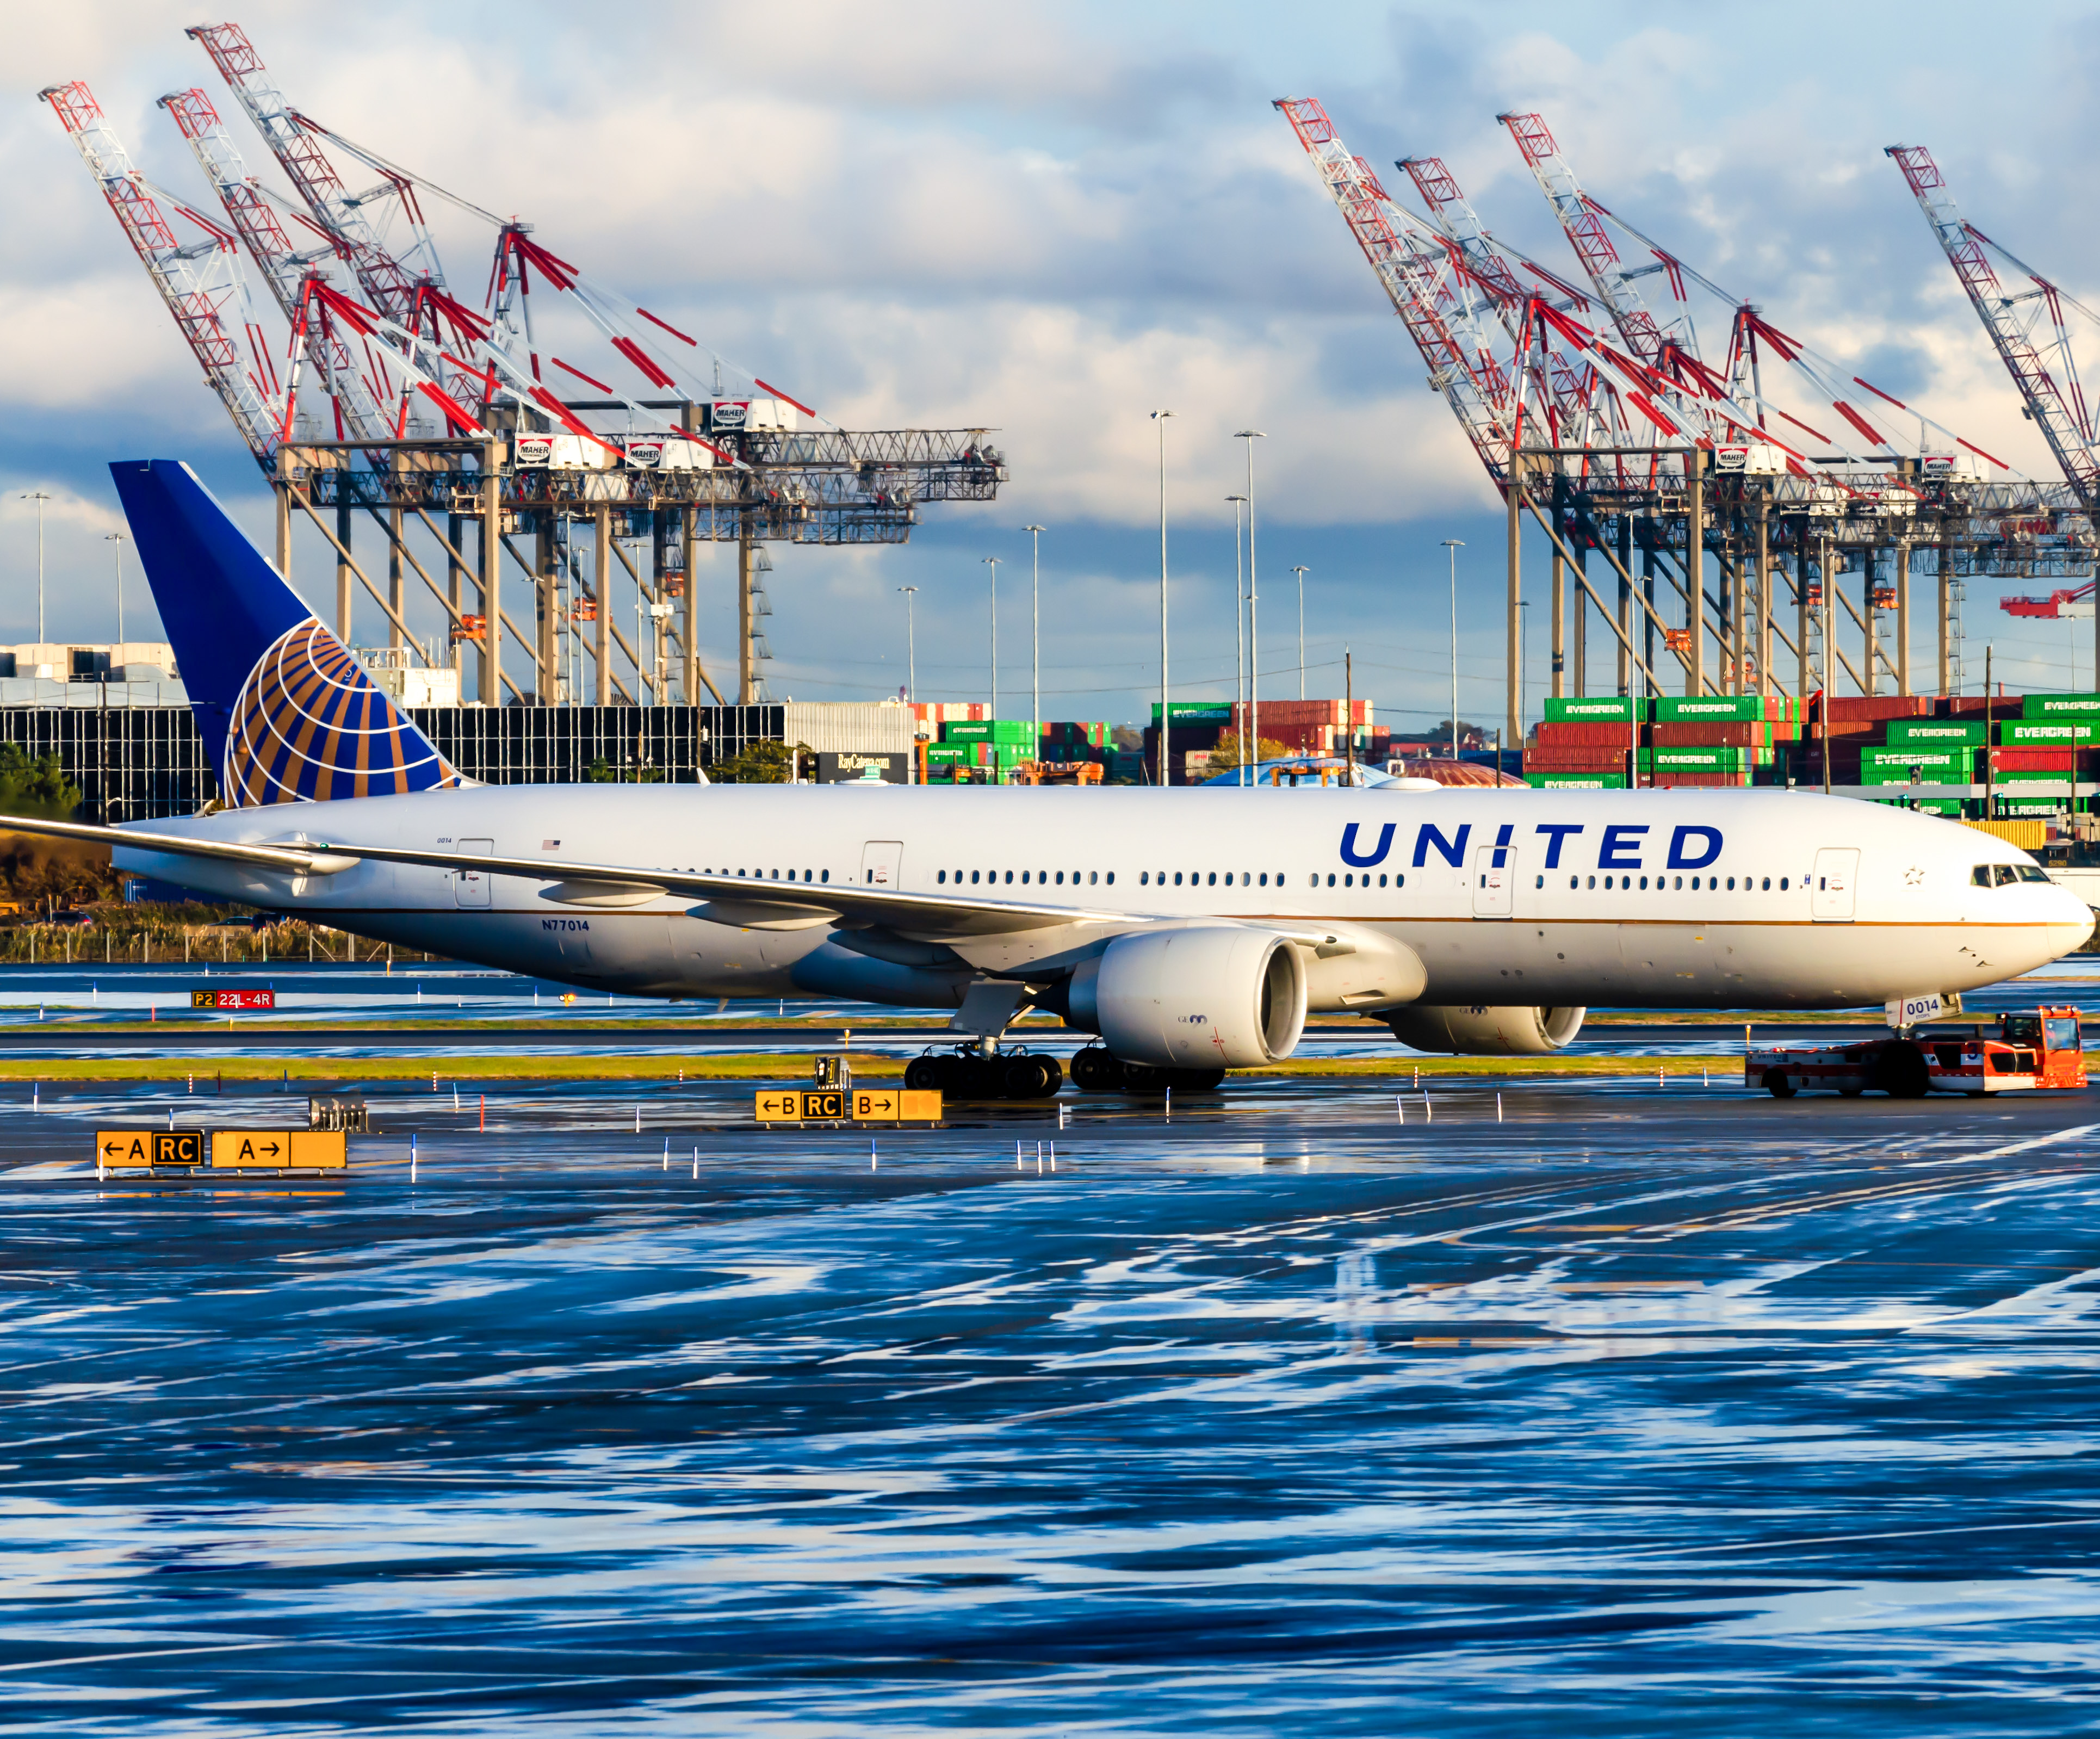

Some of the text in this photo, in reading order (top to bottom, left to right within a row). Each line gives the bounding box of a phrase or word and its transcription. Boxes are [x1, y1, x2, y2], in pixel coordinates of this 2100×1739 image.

[1566, 705, 1624, 714] EVERGREEN
[1678, 704, 1736, 713] EVERGREEN
[1909, 728, 1966, 737] EVERGREEN
[2015, 727, 2091, 738] EVERGREEN
[838, 753, 890, 772] RayCatenacom
[1658, 755, 1716, 764] EVERGREEN
[1875, 754, 1950, 765] EVERGREEN
[1545, 781, 1602, 789] EVERGREEN
[1340, 822, 1723, 869] UNITED
[542, 920, 589, 931] N77014
[196, 994, 213, 1005] P2
[220, 993, 270, 1005] 22L-4R
[1907, 999, 1938, 1015] 0014
[1967, 1043, 1978, 1060] 3
[783, 1097, 795, 1114] B
[808, 1096, 836, 1115] RC
[859, 1097, 870, 1114] B
[128, 1139, 145, 1160] A
[160, 1138, 193, 1160] RC
[239, 1139, 255, 1160] A
